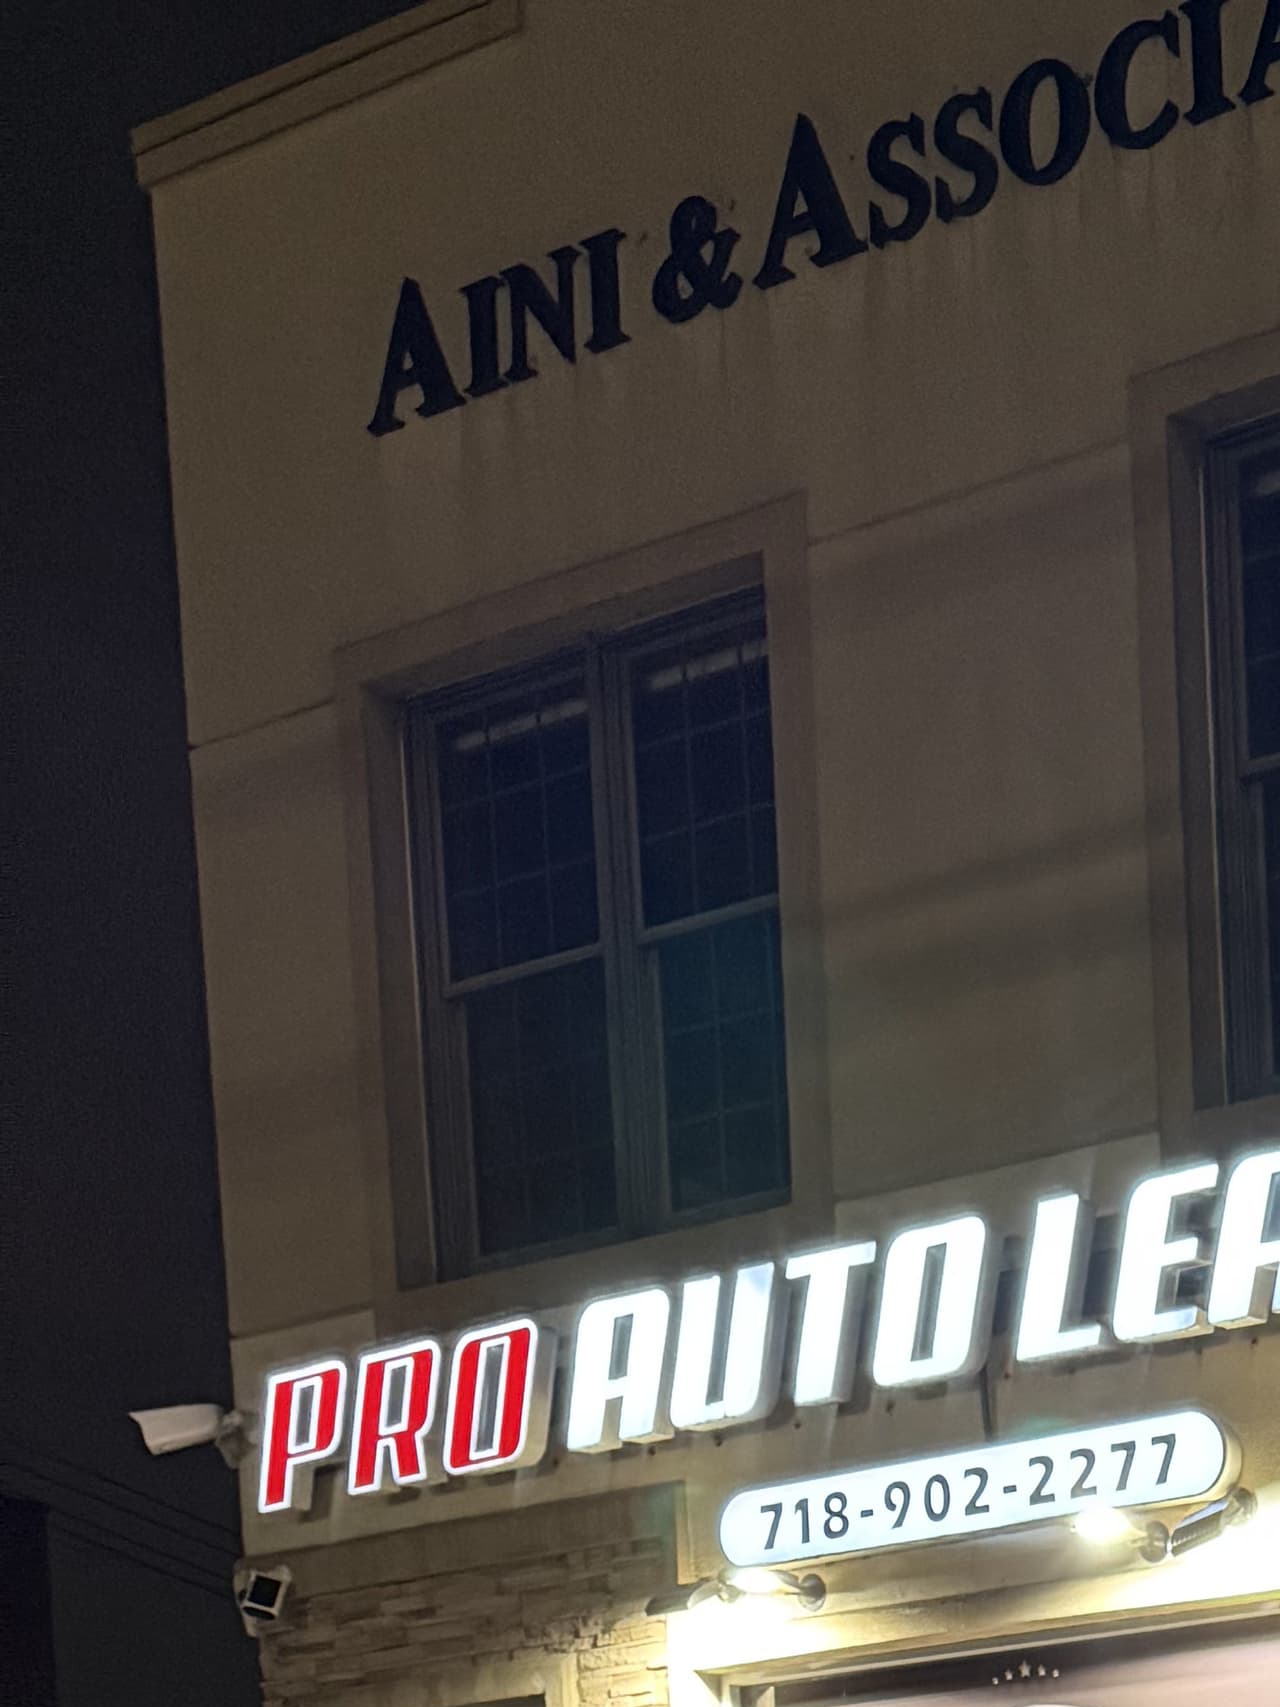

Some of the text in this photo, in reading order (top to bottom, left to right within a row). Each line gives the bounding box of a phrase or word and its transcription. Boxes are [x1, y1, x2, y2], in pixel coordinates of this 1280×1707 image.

[367, 229, 631, 437] AINI
[652, 196, 744, 325] &
[258, 1318, 539, 1514] PRO
[566, 1216, 986, 1452] AUTO
[759, 1432, 1179, 1553] 718-902-2277
